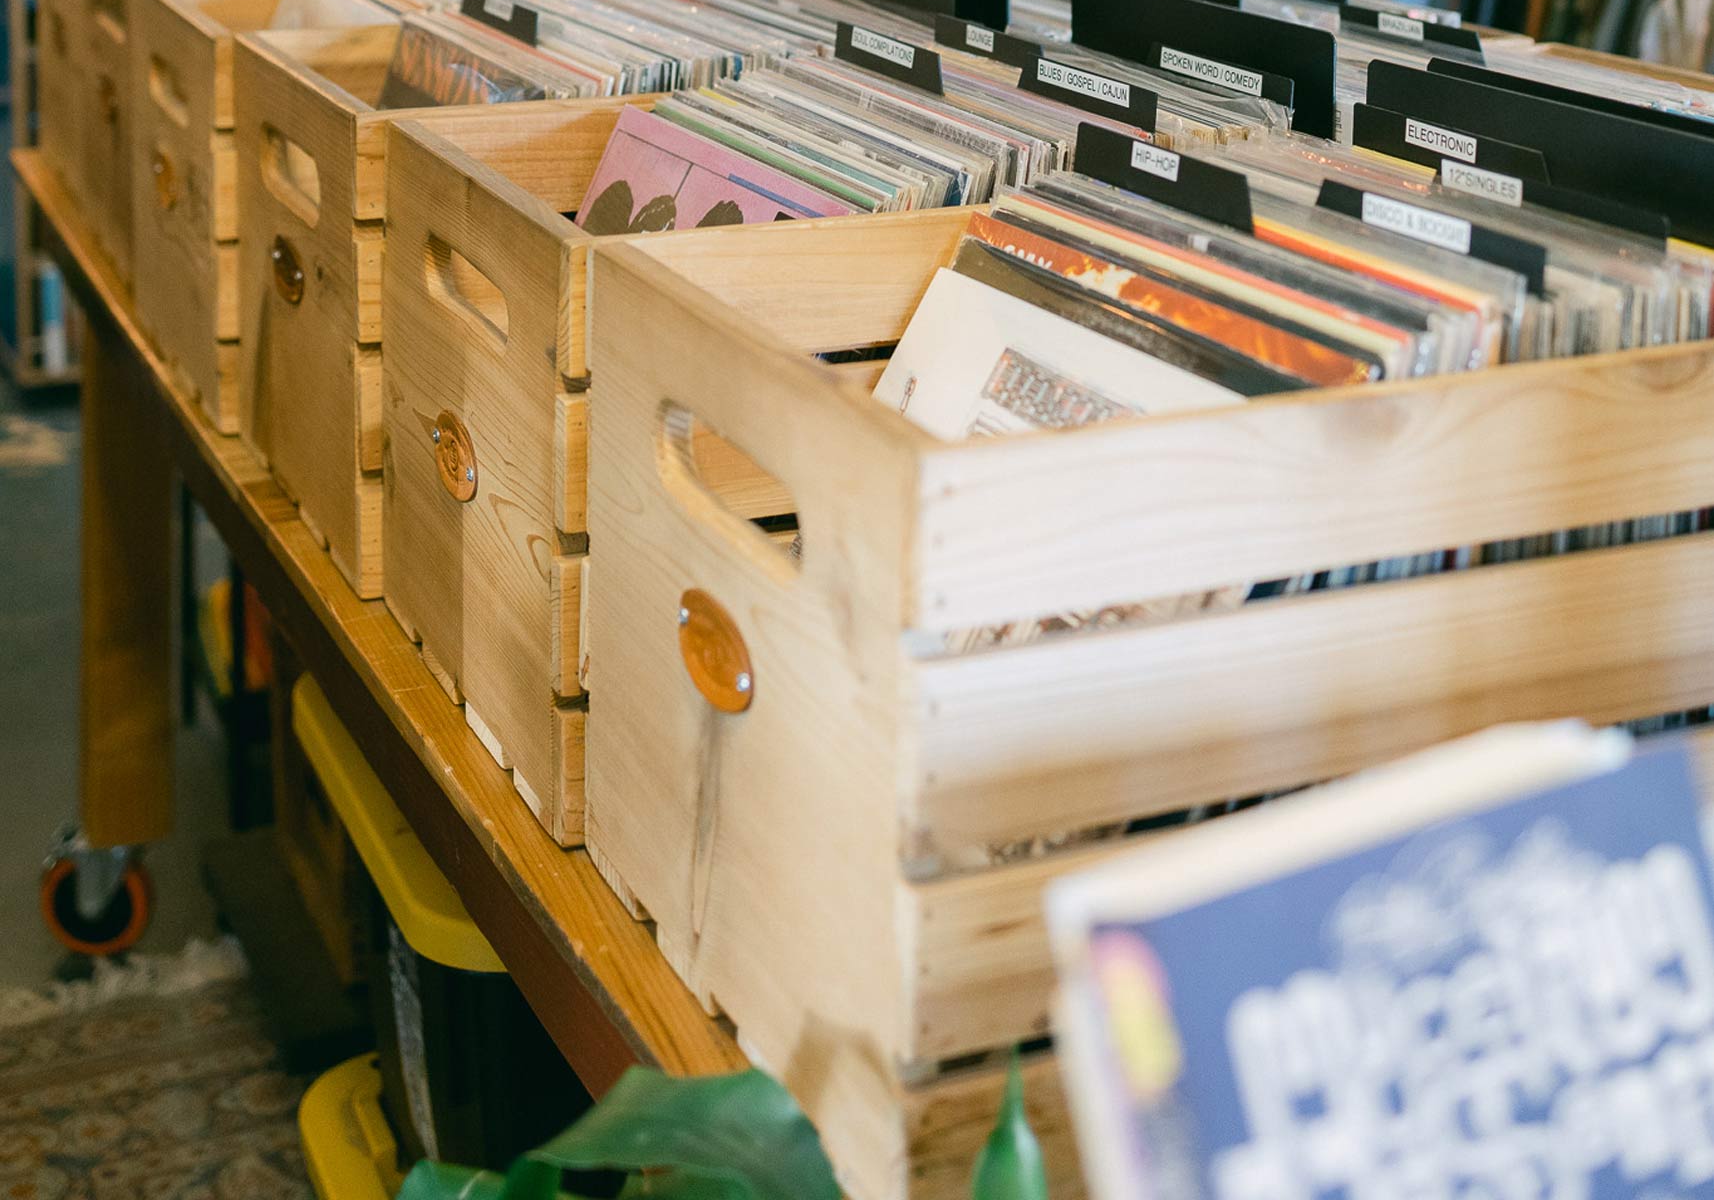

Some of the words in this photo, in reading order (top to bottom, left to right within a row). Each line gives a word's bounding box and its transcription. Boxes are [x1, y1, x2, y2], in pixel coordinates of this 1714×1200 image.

[853, 30, 869, 46] SOUL
[869, 36, 913, 64] COMPILATIONS
[967, 29, 993, 48] LOUNGE
[1039, 63, 1062, 82] BLUES
[1067, 72, 1096, 93] GOSPEL
[1102, 82, 1128, 101] CAJUN
[1162, 51, 1193, 71] SPOKEN
[1194, 61, 1219, 79] WORD
[1224, 69, 1261, 91] COMEDY
[1408, 124, 1474, 157] ELECTRONIC
[1134, 147, 1177, 173] HIP-HOP
[1365, 199, 1404, 226] DISCO
